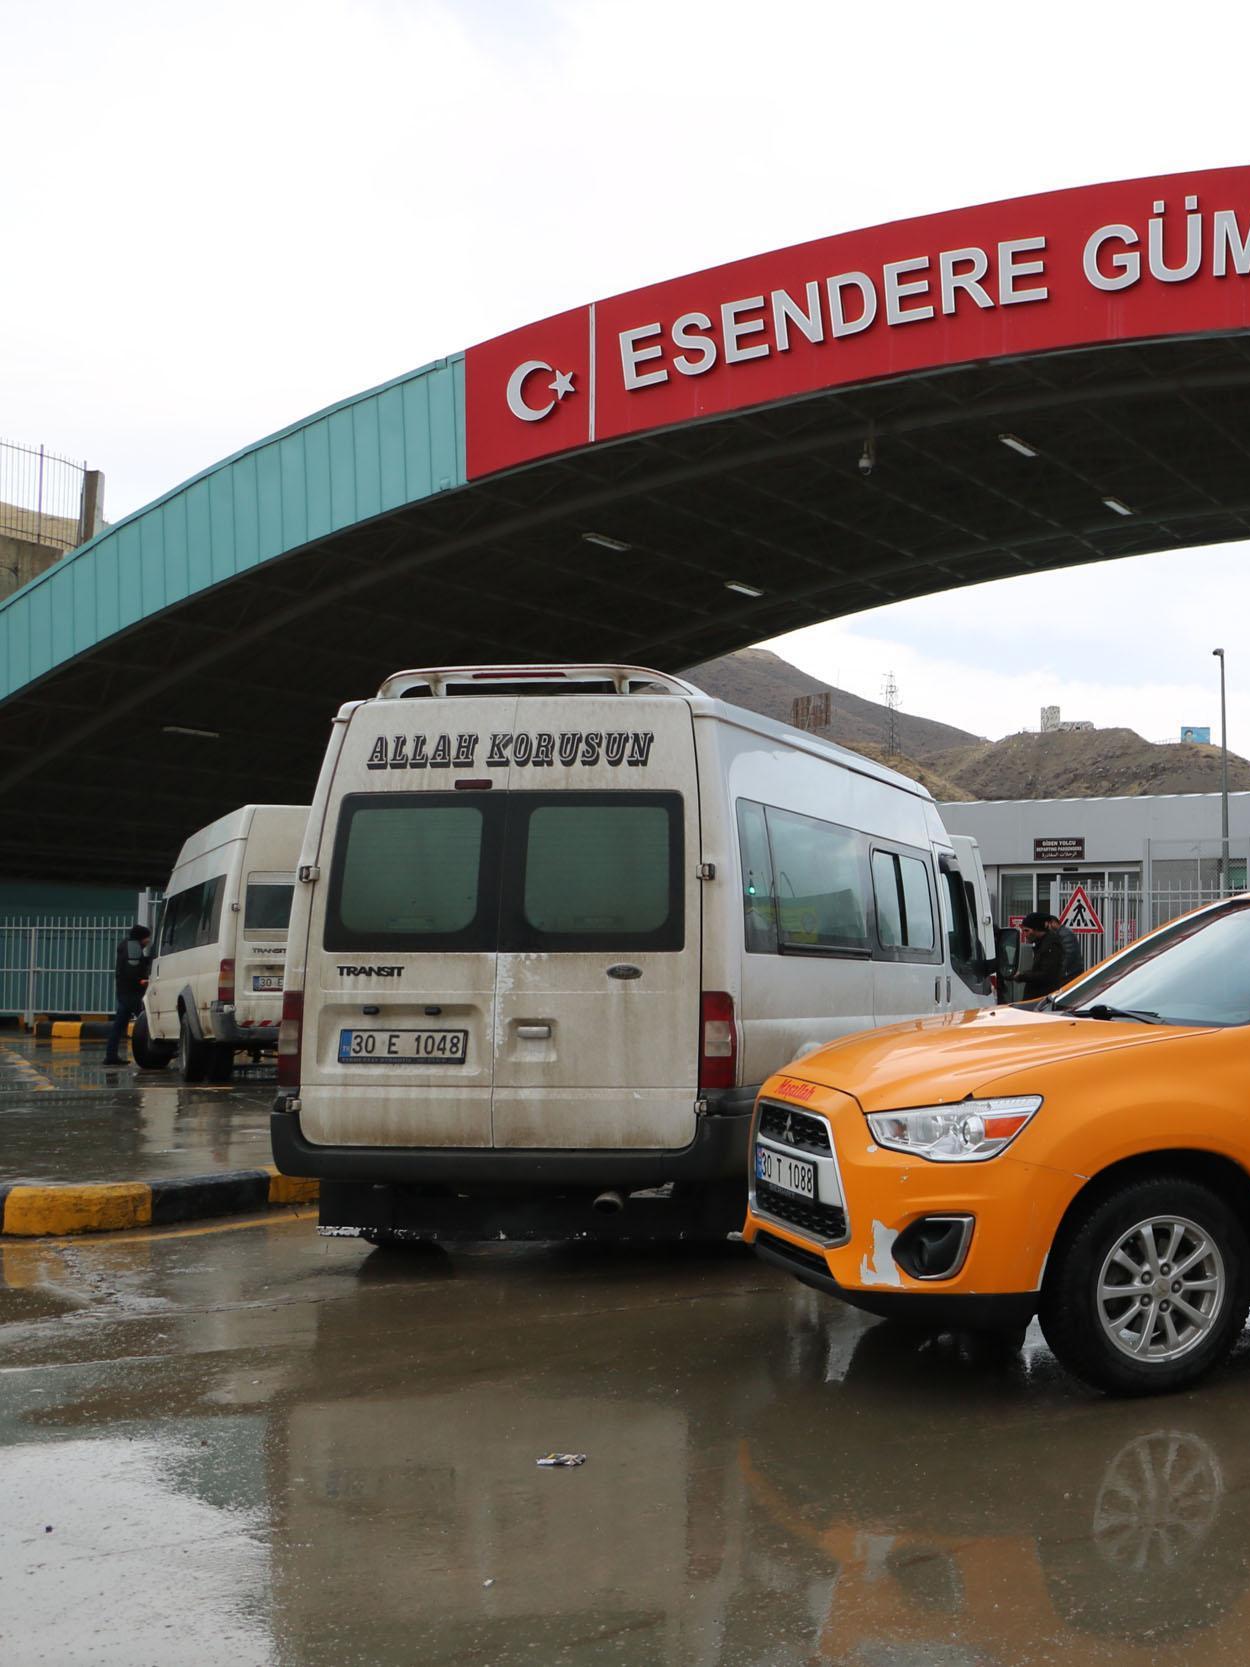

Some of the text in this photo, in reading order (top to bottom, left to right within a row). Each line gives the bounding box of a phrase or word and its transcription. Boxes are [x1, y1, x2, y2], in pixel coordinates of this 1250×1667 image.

[618, 236, 1048, 391] ESENDERE
[367, 731, 654, 770] ALLAH KORUSUN
[260, 978, 272, 986] 30
[336, 965, 405, 977] TRANSIT
[352, 1034, 460, 1055] 30 E 1048
[762, 1151, 772, 1179] 30
[776, 1157, 782, 1183] T
[788, 1161, 813, 1193] 1088
